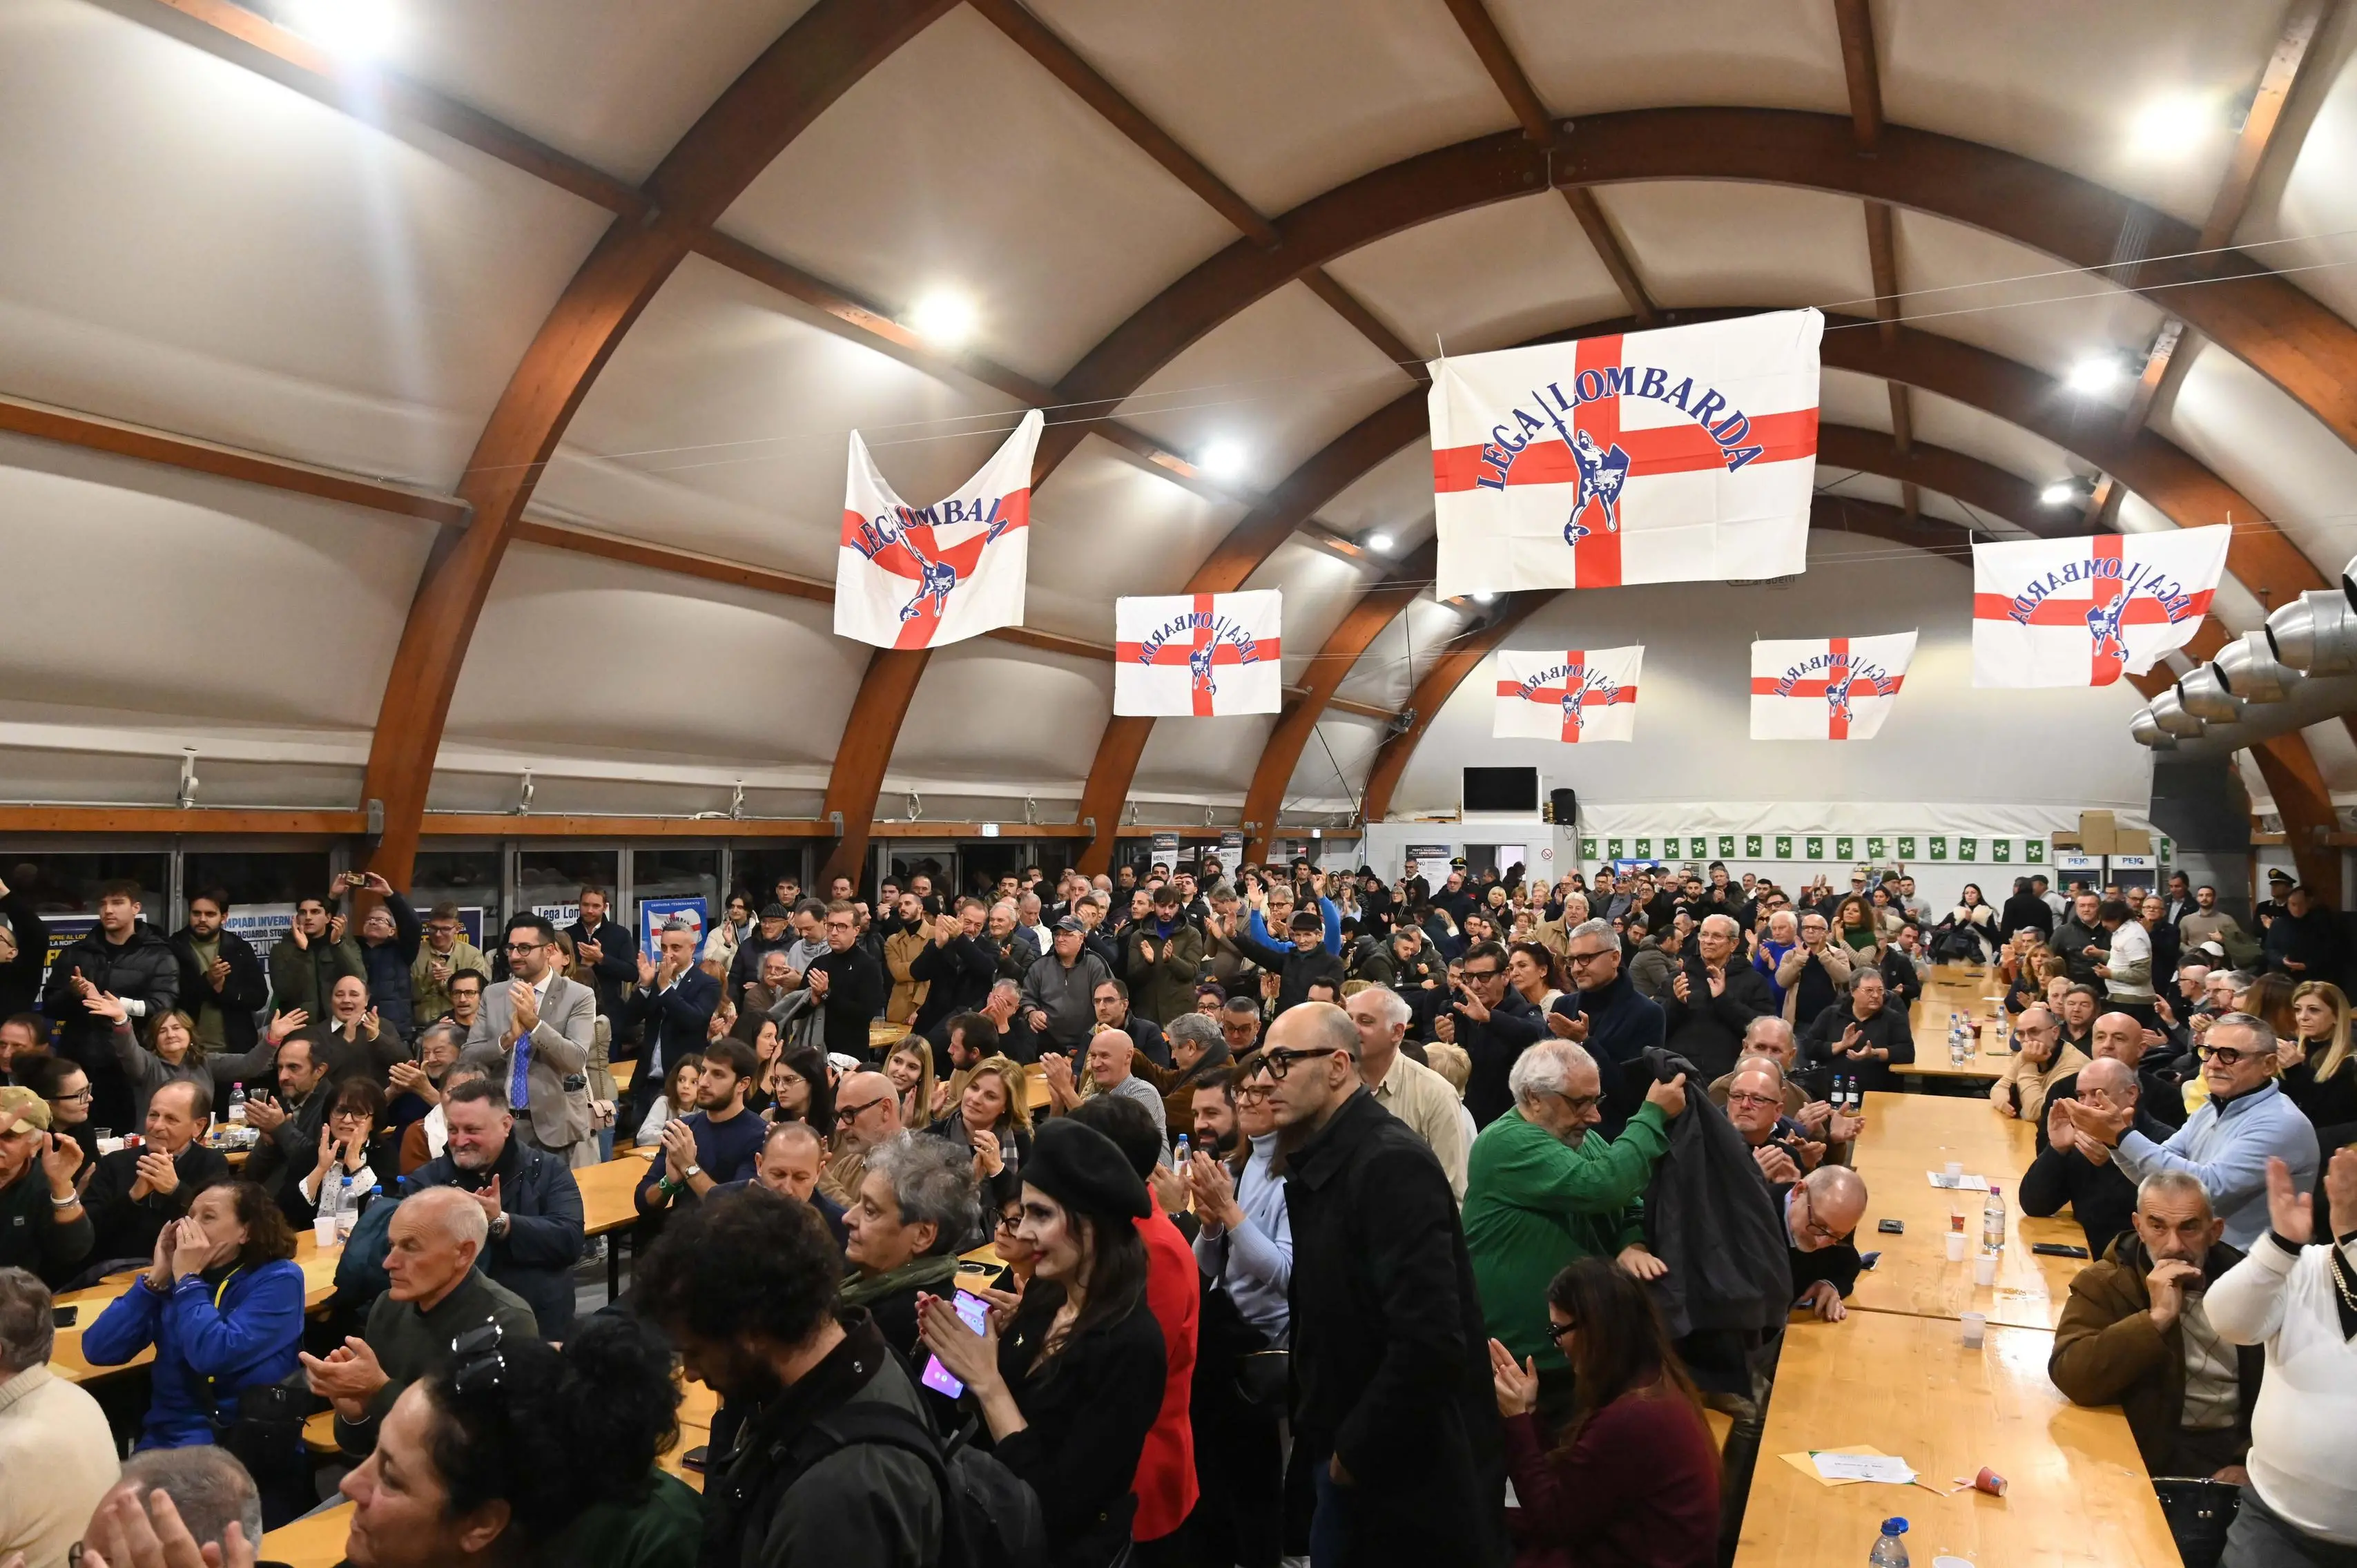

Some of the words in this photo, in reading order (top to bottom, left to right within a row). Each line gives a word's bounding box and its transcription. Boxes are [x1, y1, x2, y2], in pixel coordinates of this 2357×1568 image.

[1477, 408, 1544, 492] LEGA
[1546, 366, 1763, 473] LOMBARDA
[850, 514, 897, 561] LEG
[895, 498, 1009, 545] OMBAA
[224, 917, 255, 929] MPIADI
[539, 907, 559, 921] Lega
[563, 906, 580, 918] Lom
